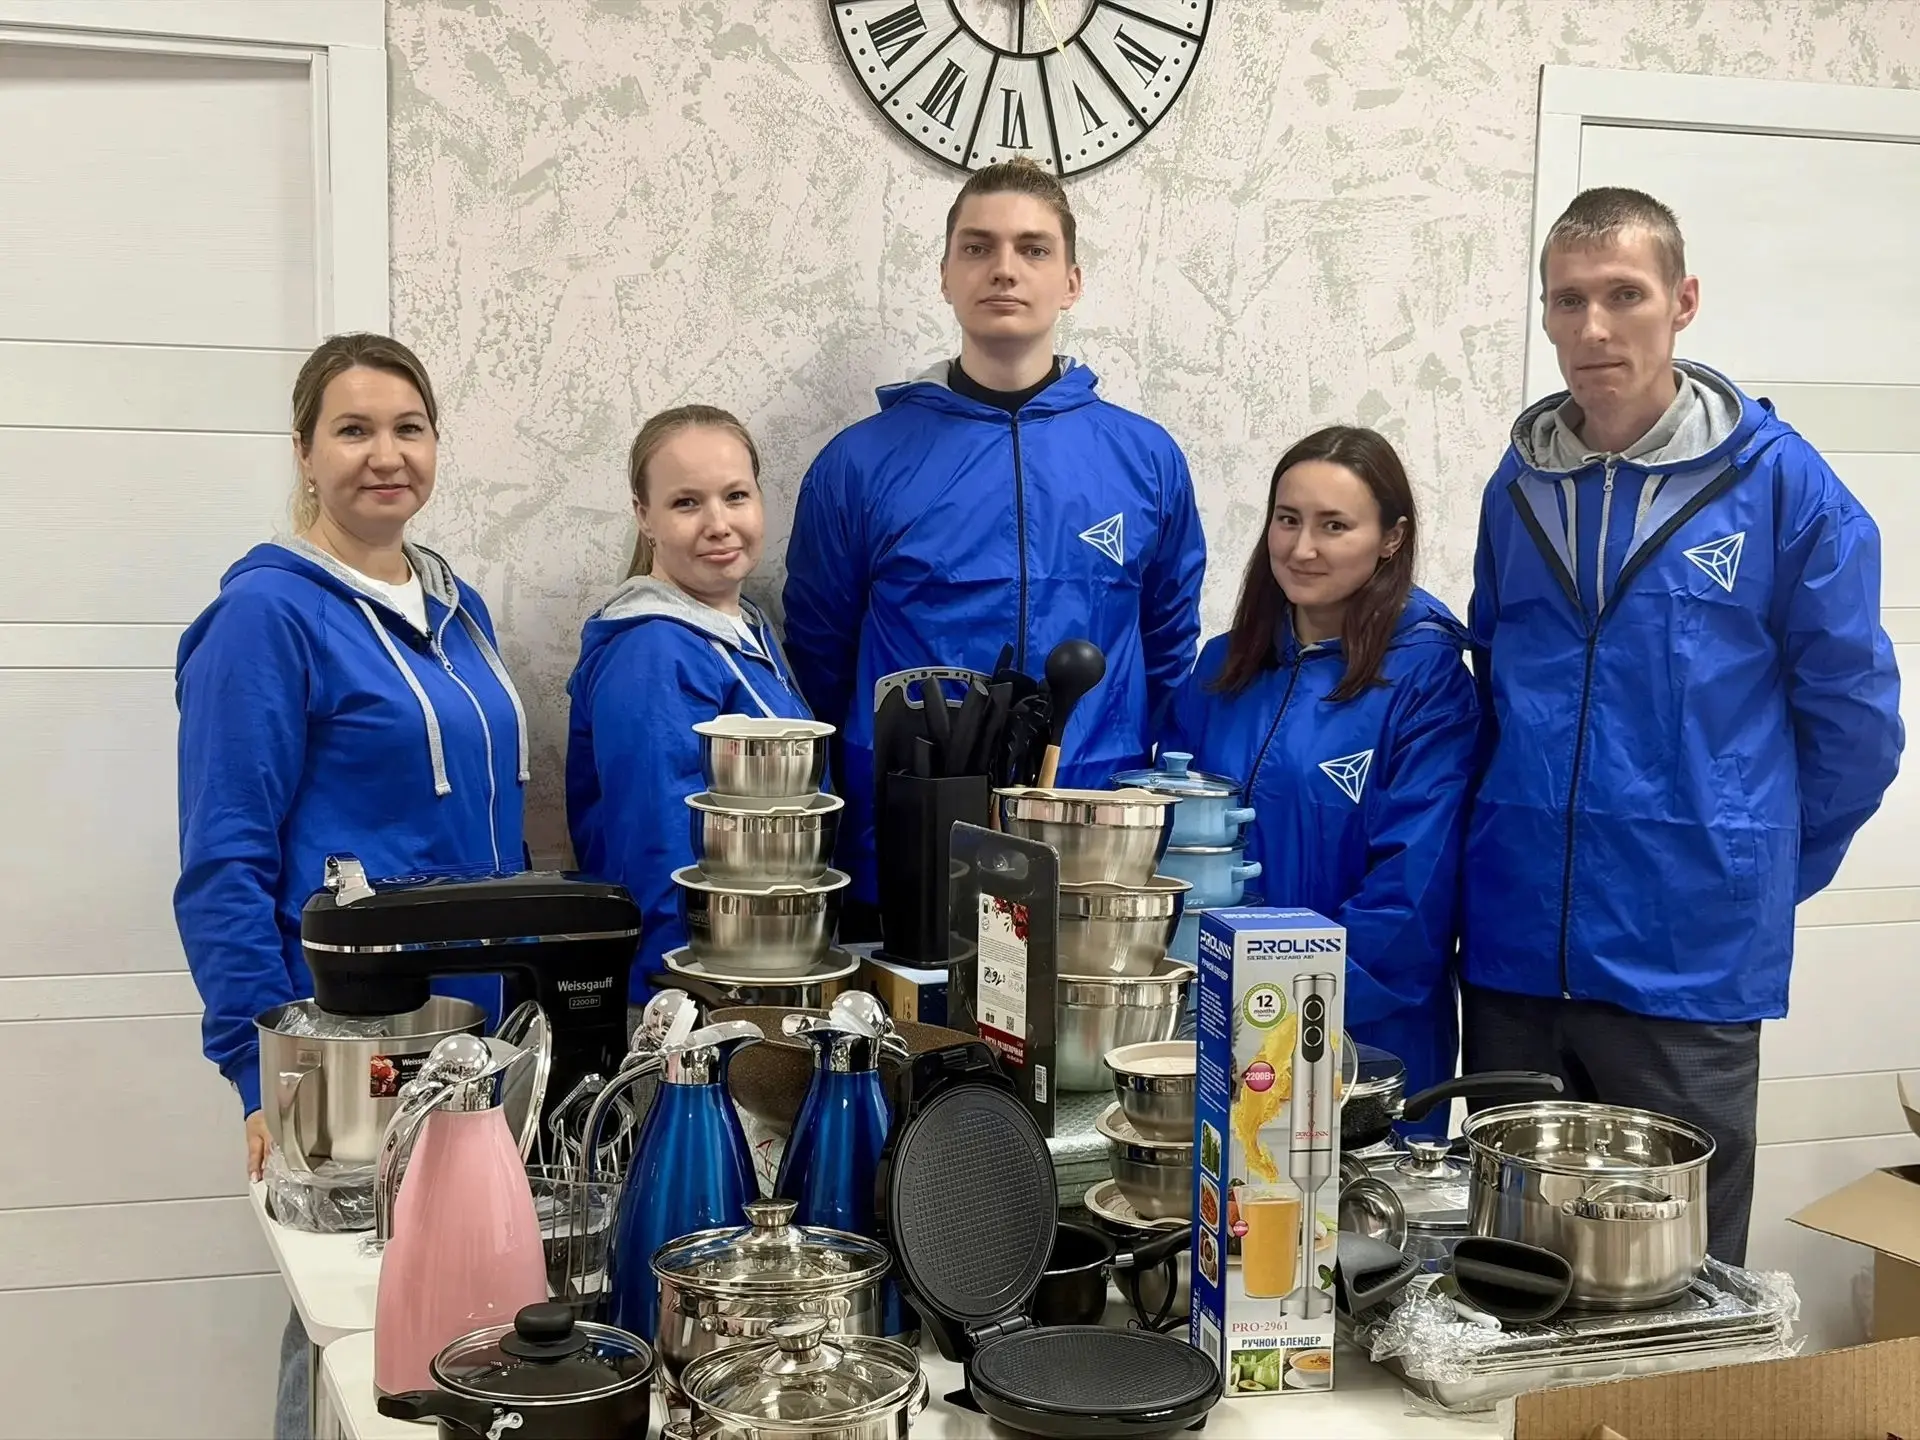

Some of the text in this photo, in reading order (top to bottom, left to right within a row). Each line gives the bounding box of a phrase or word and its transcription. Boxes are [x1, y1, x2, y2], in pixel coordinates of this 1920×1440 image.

[1246, 938, 1342, 955] PROLISS
[557, 976, 613, 993] Weissgauff
[1256, 994, 1273, 1008] 12
[1231, 1320, 1289, 1333] PRO-2961
[1241, 1336, 1322, 1348] РУЧНОЙ БЛЕНДЕР
